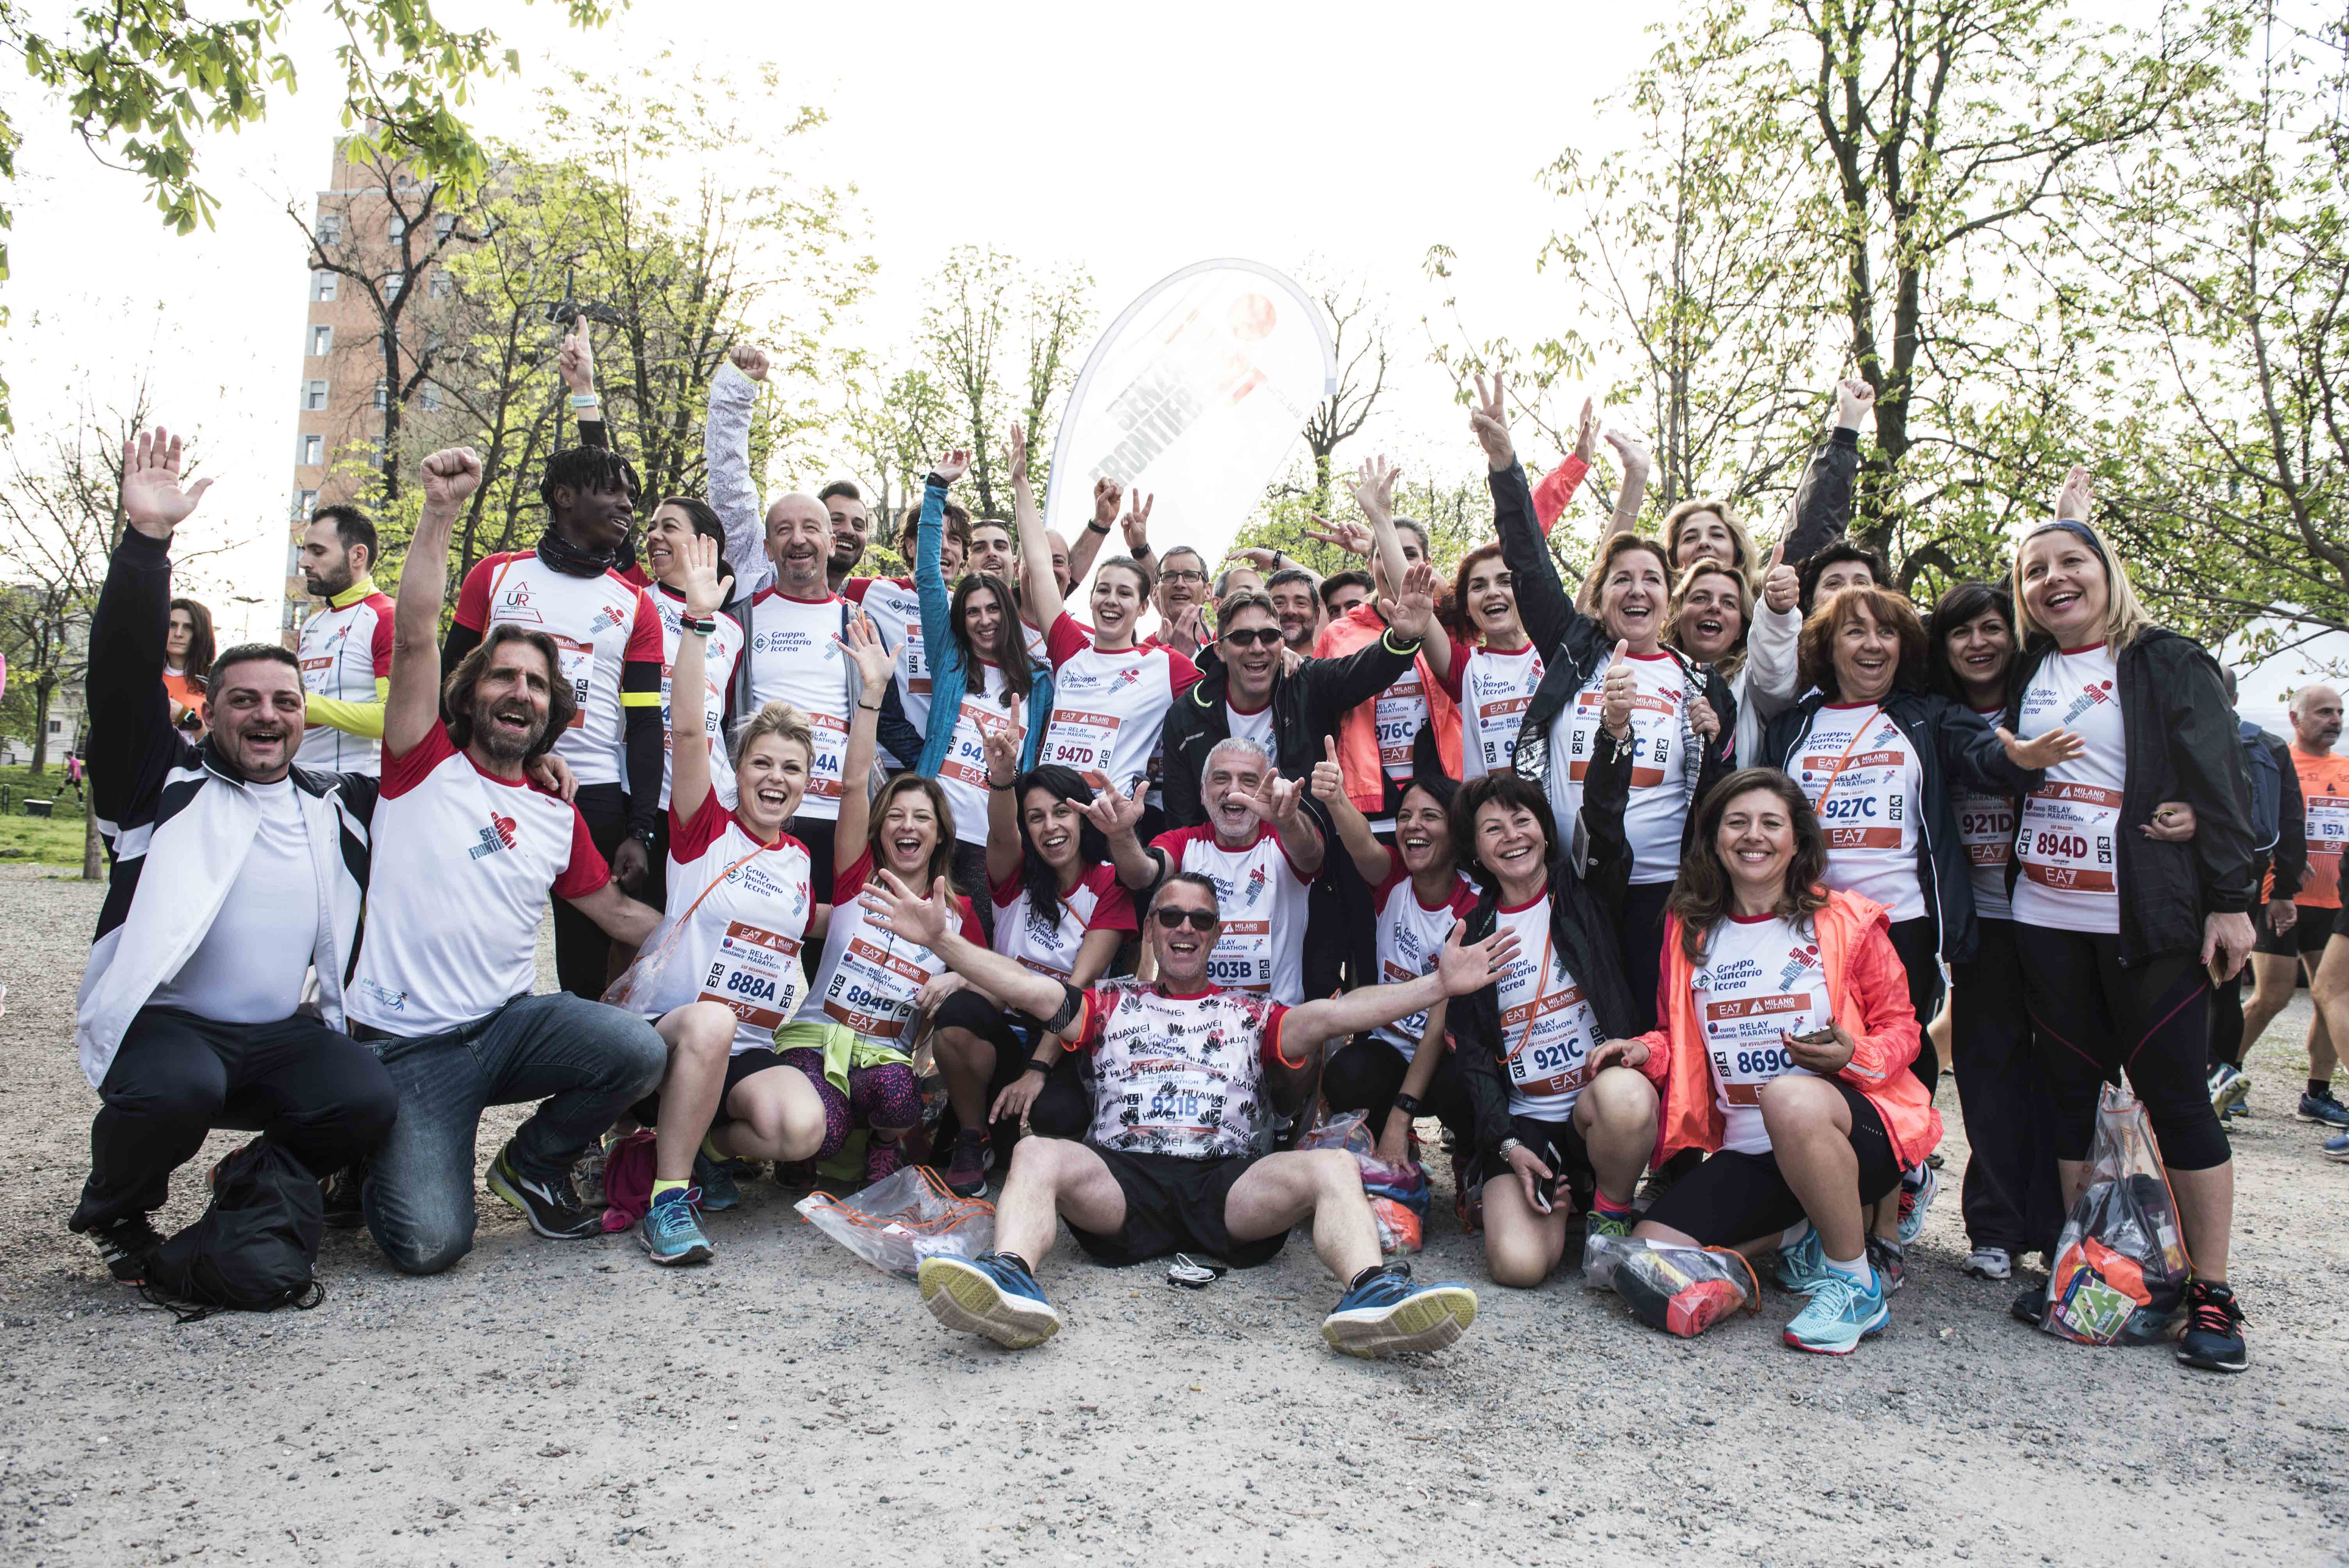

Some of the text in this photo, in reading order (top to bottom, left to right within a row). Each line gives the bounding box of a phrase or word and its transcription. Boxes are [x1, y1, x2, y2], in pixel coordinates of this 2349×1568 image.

[507, 593, 529, 606] UR
[603, 606, 622, 627] SPORT
[2031, 688, 2057, 698] Gruppo
[2083, 684, 2109, 705] SPORT
[1490, 702, 1508, 713] EA7
[1636, 697, 1662, 706] MILANO
[2026, 697, 2057, 706] bancario
[2069, 693, 2091, 710] SENZA
[2062, 697, 2096, 725] FRONTIERE
[1376, 722, 1414, 742] 876C
[1481, 726, 1505, 734] assistance
[1811, 731, 1851, 740] Gruppo
[1056, 745, 1093, 763] 947D
[1381, 747, 1409, 761] EA7
[1834, 778, 1875, 788] MARATHON
[2073, 793, 2105, 803] MARATHON
[2074, 786, 2105, 798] MILANO
[1826, 797, 1877, 819] 927C
[2048, 805, 2071, 814] RELAY
[1962, 814, 2014, 835] 921D
[2046, 813, 2084, 822] MARATHON
[1833, 829, 1867, 843] EA7
[2322, 823, 2344, 836] 157A
[1971, 844, 2007, 859] EA7
[2037, 832, 2088, 859] 894D
[2045, 867, 2078, 885] EA7
[743, 881, 771, 898] Iccrea
[1246, 879, 1258, 896] SENZA
[741, 927, 763, 941] EA7
[732, 944, 747, 955] europ
[777, 939, 793, 950] MILANO
[1031, 934, 1055, 951] Iccrea
[720, 948, 745, 960] assistance
[749, 949, 774, 961] RELAY
[861, 945, 882, 960] EA7
[1399, 943, 1418, 961] Iccrea
[1789, 947, 1818, 969] SPORT
[747, 956, 781, 971] MARATHON
[841, 961, 864, 975] assistance
[852, 960, 866, 971] europ
[898, 962, 921, 976] MILANO
[1206, 961, 1252, 978] 903B
[1780, 960, 1800, 977] SENZA
[748, 966, 778, 979] BESAMERUNNER
[868, 967, 893, 982] RELAY
[897, 968, 919, 980] MARATHON
[1779, 964, 1807, 992] FRONTIERE
[727, 971, 776, 1001] 888A
[866, 971, 902, 993] MARATHON
[1498, 979, 1526, 995] Iccrea
[1714, 980, 1747, 991] Iccrea
[847, 985, 896, 1012] 894B
[1547, 991, 1574, 1007] MILANO
[1764, 997, 1795, 1006] MILANO
[1506, 1008, 1526, 1022] EA7
[1719, 1003, 1741, 1015] EA7
[847, 1012, 879, 1031] EA7
[1531, 1019, 1572, 1037] MARATHON
[1739, 1021, 1769, 1031] RELAY
[1108, 1023, 1150, 1042] HUAWEI
[1740, 1027, 1786, 1037] MARATHON
[1538, 1035, 1559, 1046] COLLEGHI
[1186, 1054, 1229, 1069] HUAWEI
[1534, 1038, 1584, 1070] 921C
[1142, 1064, 1185, 1076] HUAWEI
[1550, 1068, 1583, 1090] EA7
[1182, 1089, 1228, 1105] HUAWEI
[1151, 1096, 1199, 1117] 921B
